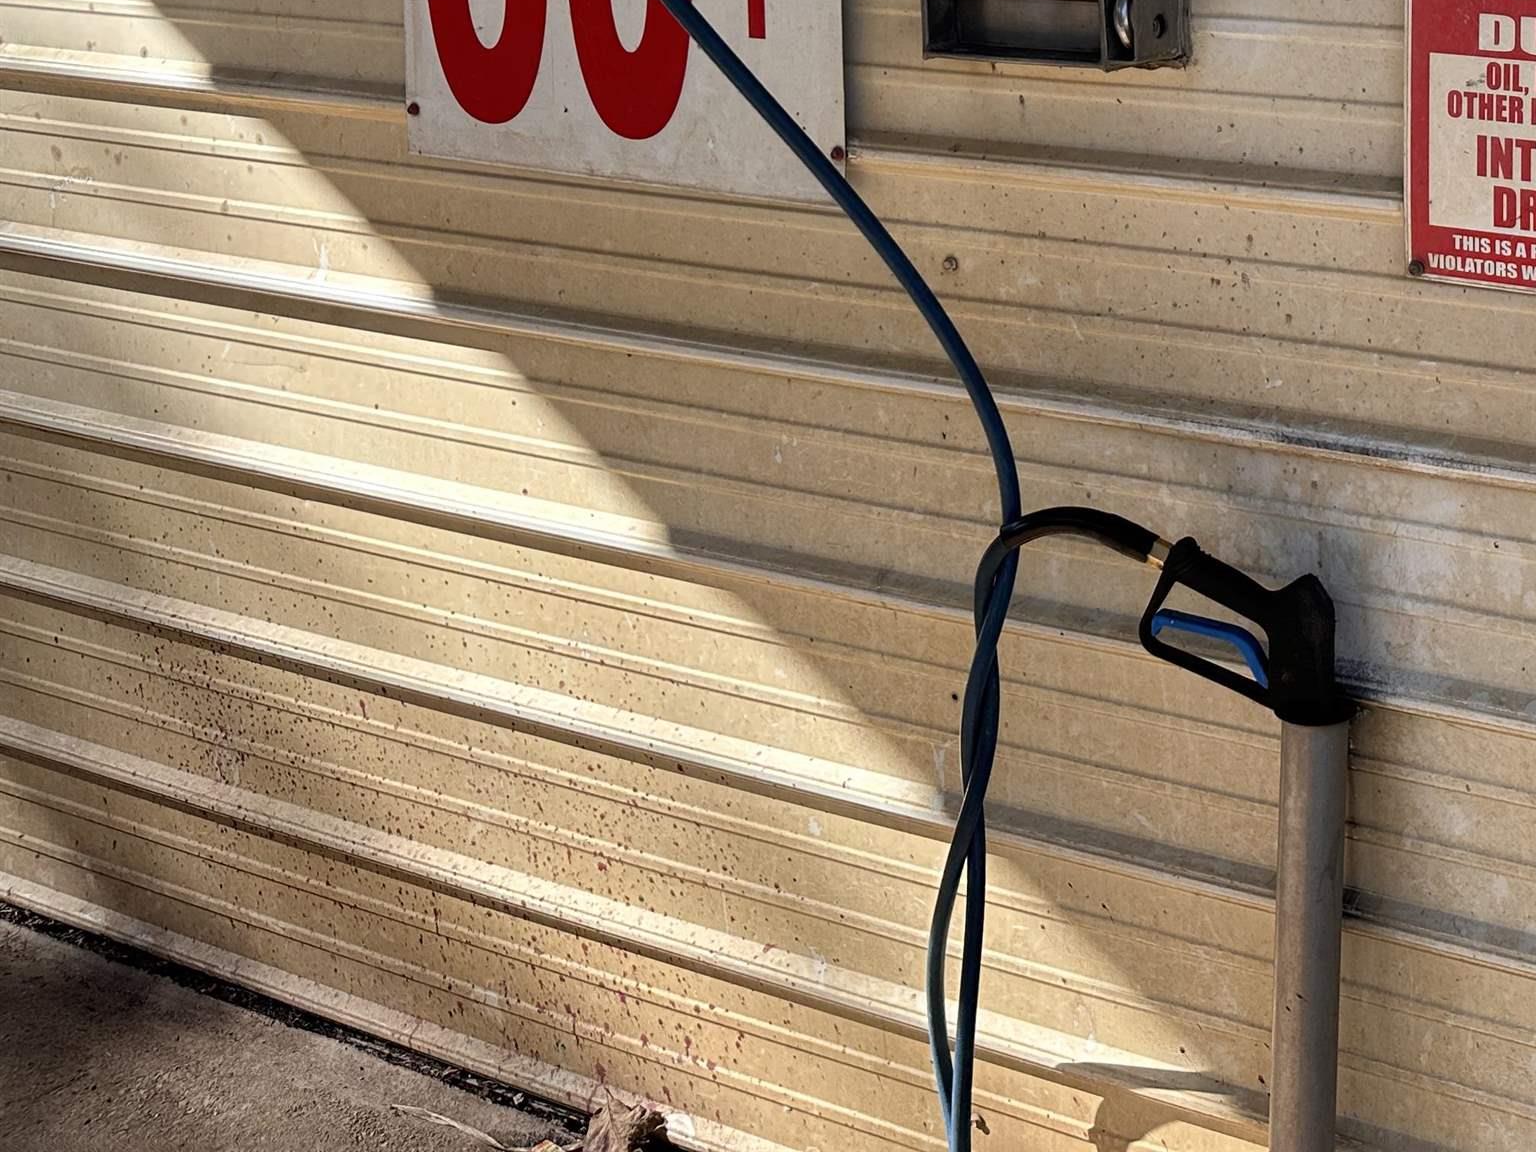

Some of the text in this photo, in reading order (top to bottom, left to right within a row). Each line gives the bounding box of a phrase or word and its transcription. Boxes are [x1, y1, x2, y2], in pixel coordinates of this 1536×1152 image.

[1485, 61, 1529, 96] OIL,
[1447, 90, 1524, 125] OTHER
[1452, 234, 1491, 254] THIS
[1495, 238, 1511, 256] IS
[1515, 240, 1528, 258] A
[1427, 253, 1518, 280] VIOLATORS
